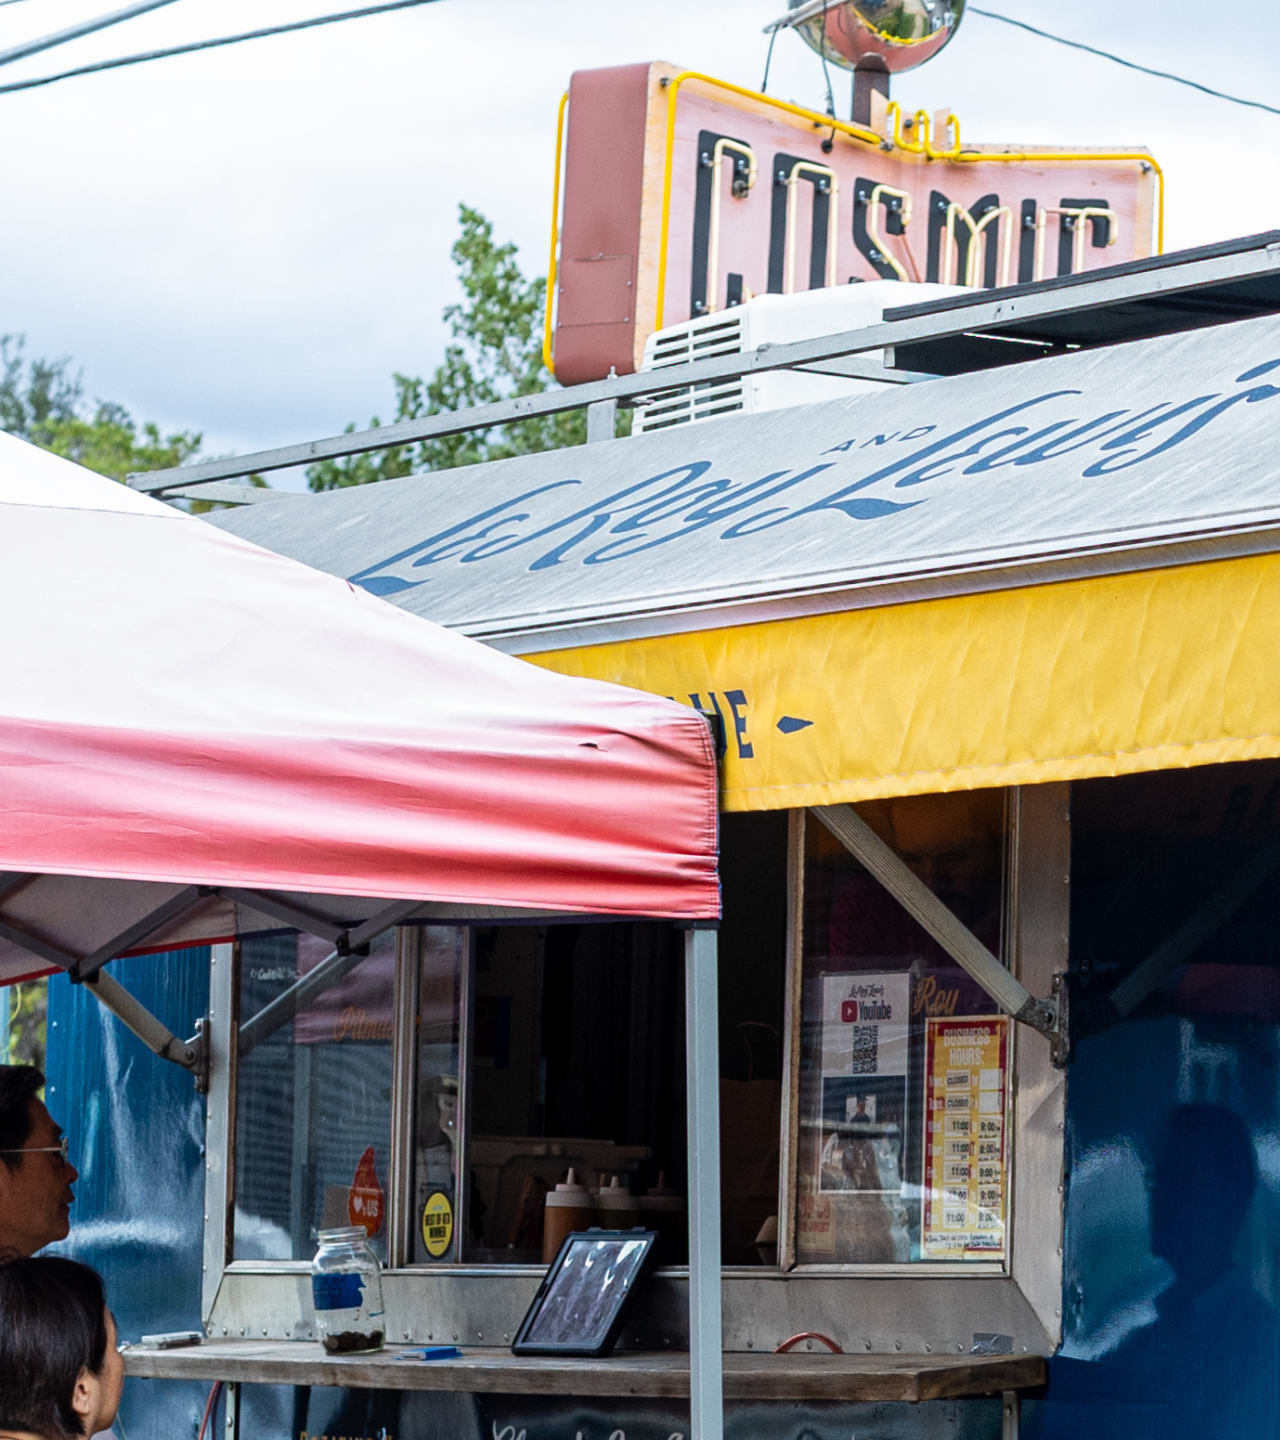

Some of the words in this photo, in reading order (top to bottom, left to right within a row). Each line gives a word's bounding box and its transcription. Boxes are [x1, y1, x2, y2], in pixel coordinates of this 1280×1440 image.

[820, 423, 935, 456] AND
[859, 1000, 892, 1021] YouTube
[943, 1028, 990, 1046] BUSINESS
[947, 1075, 969, 1085] CLOSED
